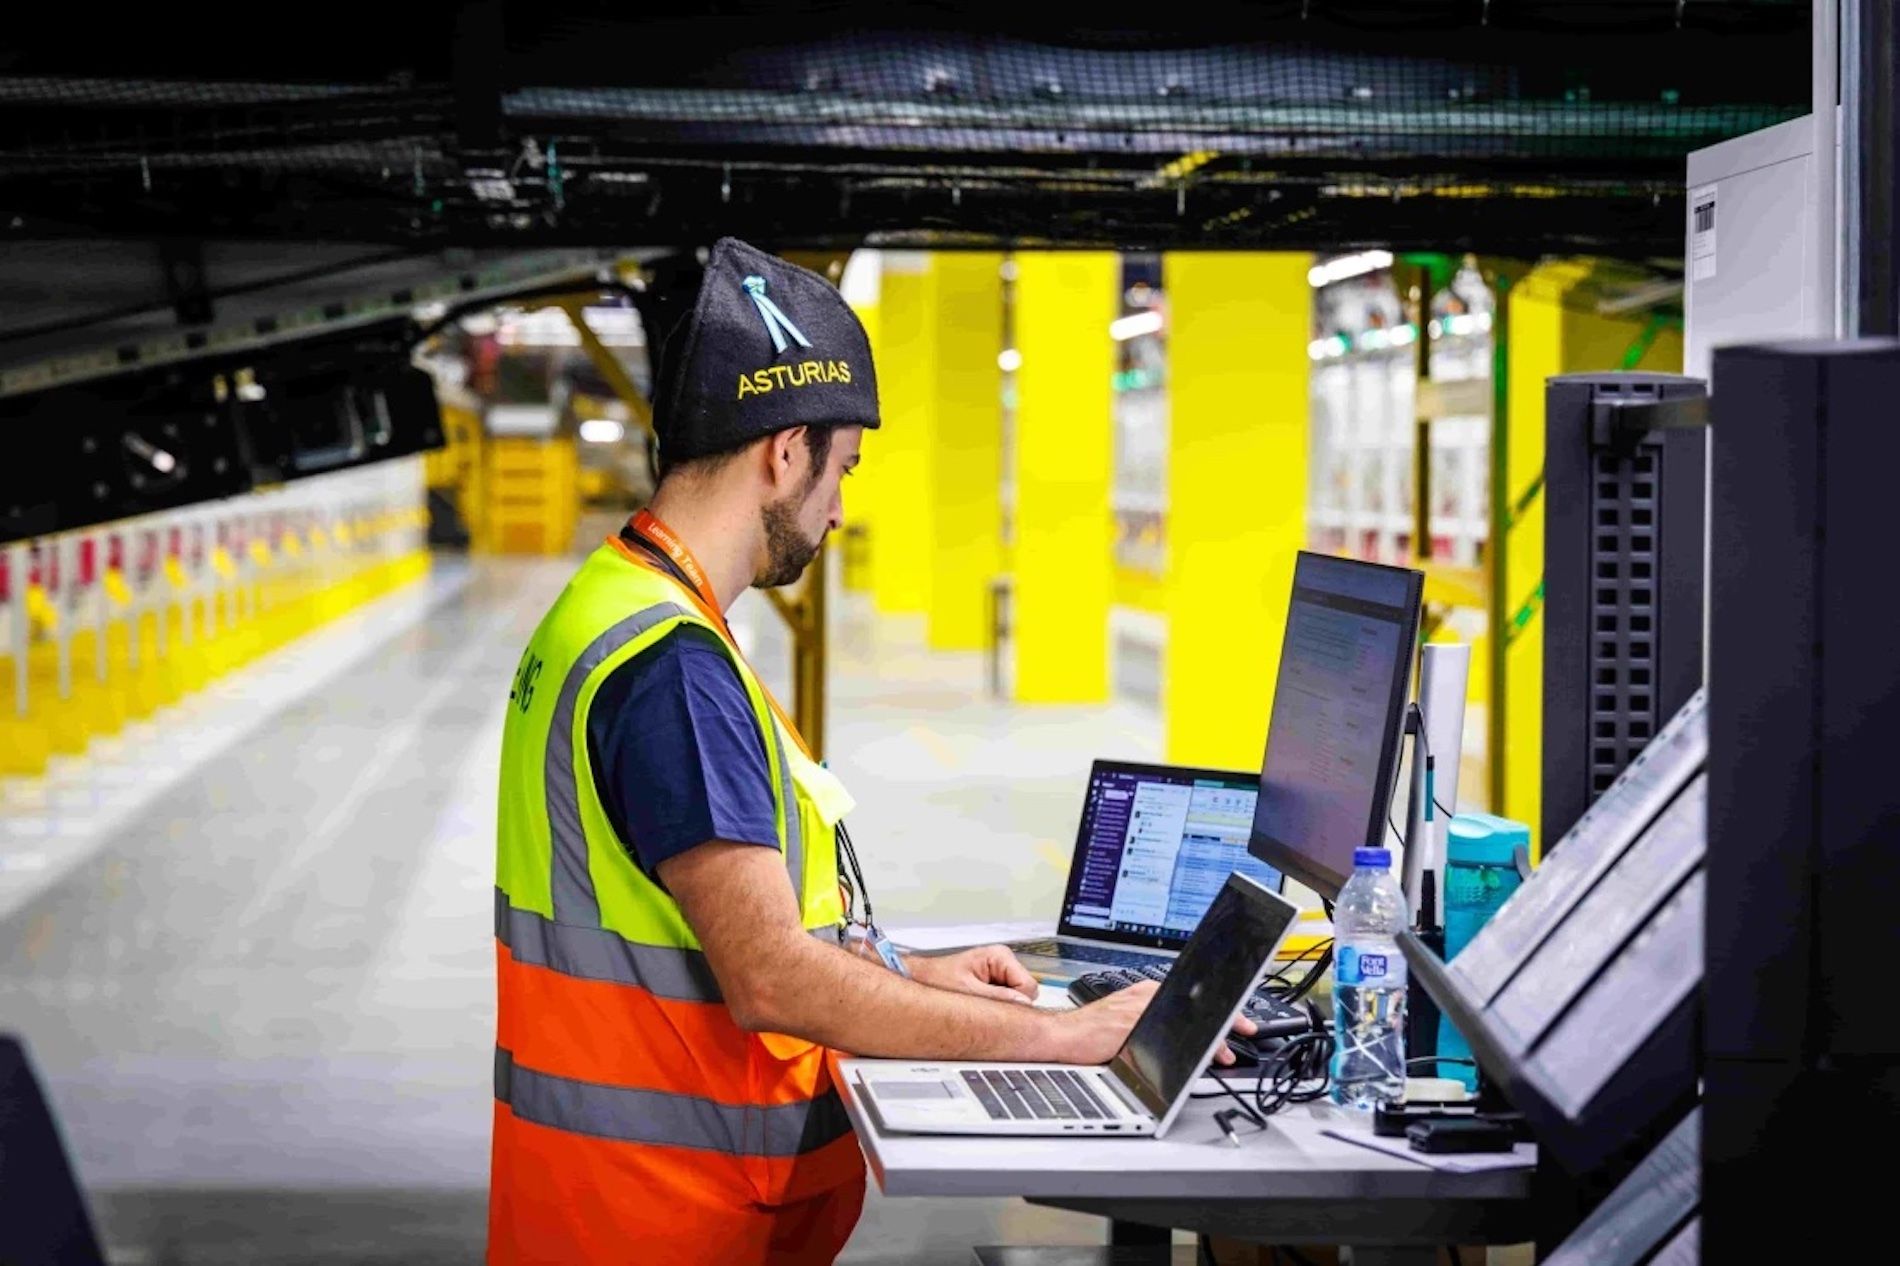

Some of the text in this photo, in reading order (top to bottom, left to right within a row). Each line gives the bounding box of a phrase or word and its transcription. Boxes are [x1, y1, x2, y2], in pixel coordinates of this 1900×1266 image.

[737, 360, 851, 400] ASTURIAS
[648, 522, 704, 587] Learning Team
